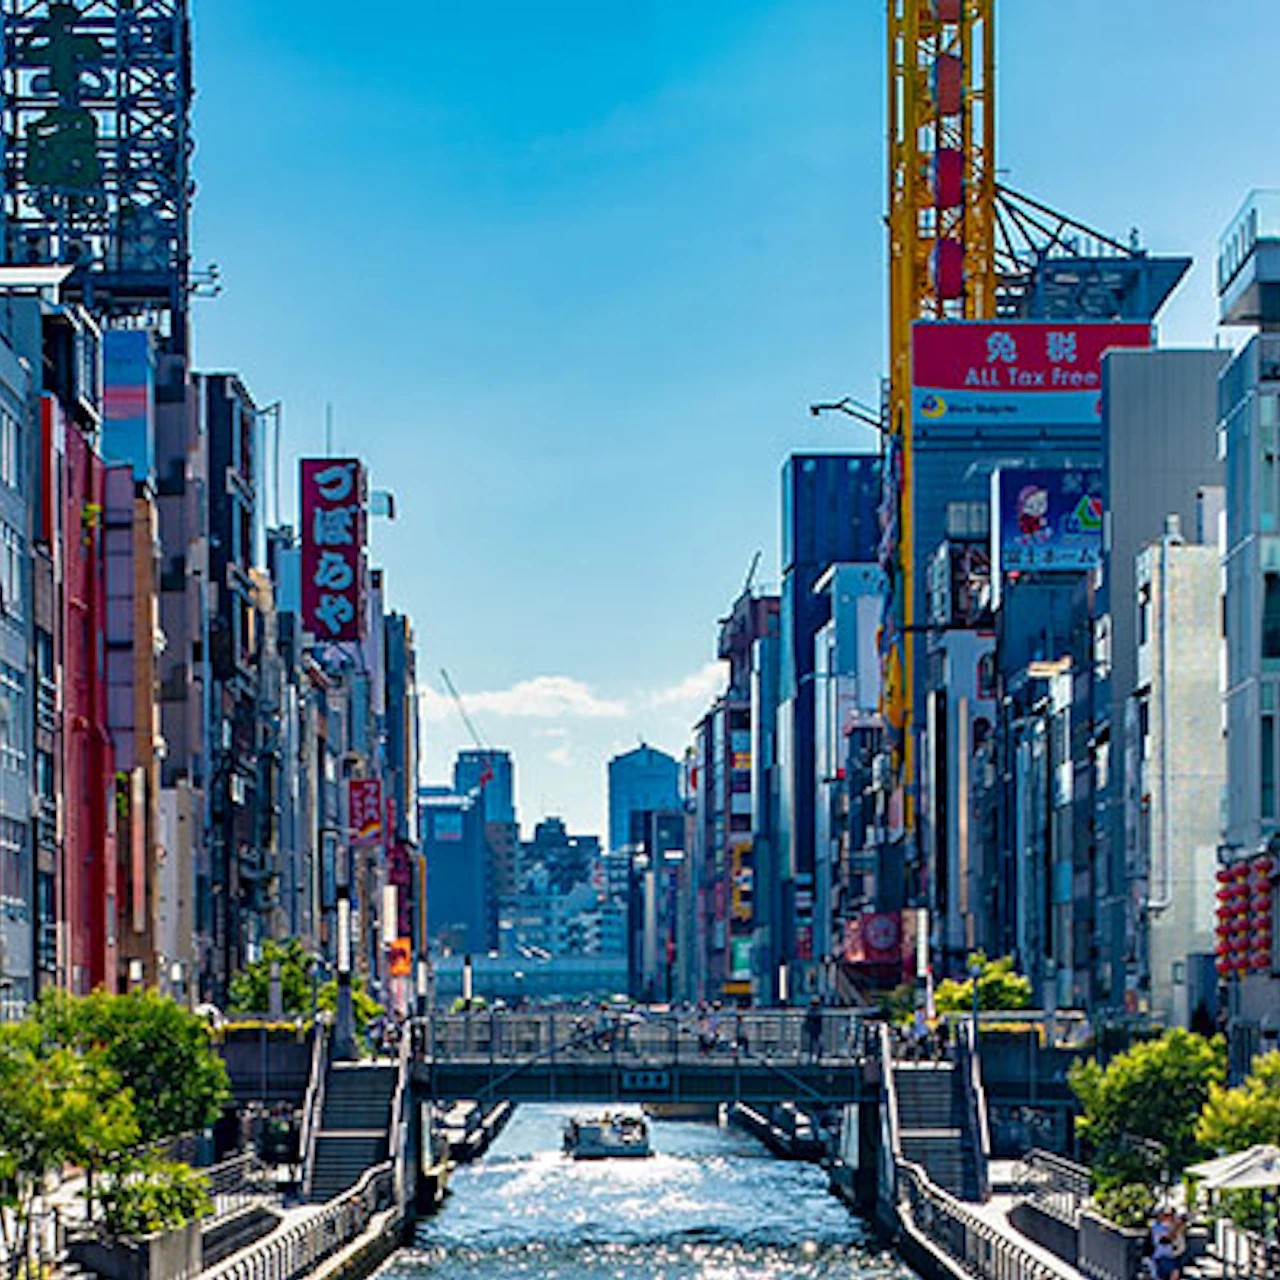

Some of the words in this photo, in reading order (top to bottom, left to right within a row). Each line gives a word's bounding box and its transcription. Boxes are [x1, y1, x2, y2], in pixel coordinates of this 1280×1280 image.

[986, 331, 1077, 363] 免税
[964, 366, 1000, 386] ALL
[1008, 367, 1045, 386] Tax
[1051, 367, 1099, 386] Free
